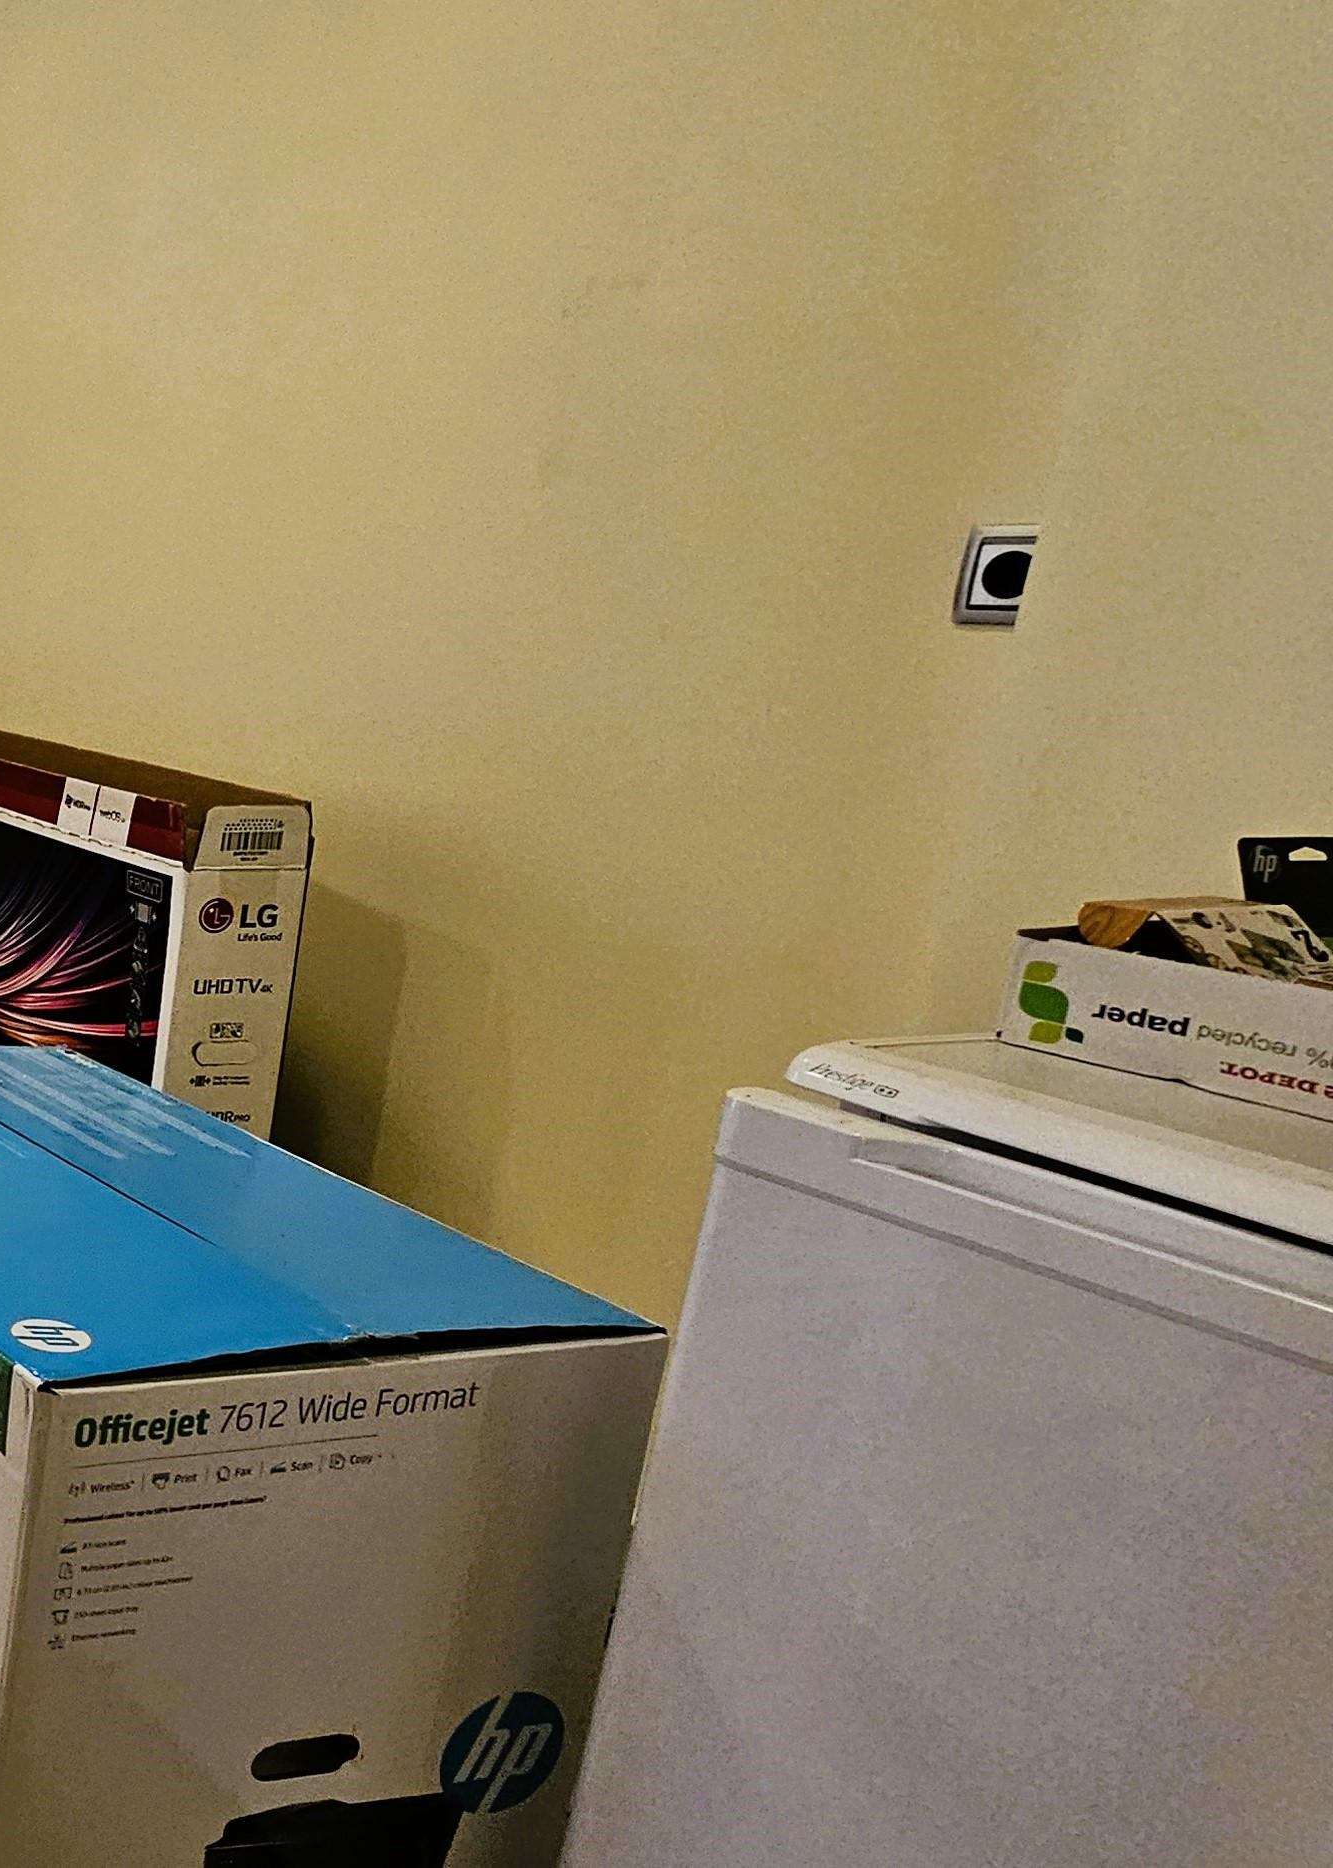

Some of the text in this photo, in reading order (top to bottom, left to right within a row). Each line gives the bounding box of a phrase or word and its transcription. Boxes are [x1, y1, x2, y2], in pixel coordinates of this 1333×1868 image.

[1252, 844, 1278, 883] hp
[129, 874, 160, 898] FRONT
[239, 903, 278, 929] LG
[237, 932, 283, 942] Life's Good
[193, 978, 234, 995] UHD
[235, 977, 263, 994] TV
[1090, 1003, 1192, 1036] paper
[1196, 1024, 1298, 1057] recycled
[74, 1381, 480, 1448] Officejet 7612 Wide Format
[173, 1473, 198, 1484] Print
[234, 1467, 252, 1478] Fax
[290, 1460, 314, 1472] Scan
[349, 1453, 374, 1466] Copy
[452, 1690, 553, 1813] hp
